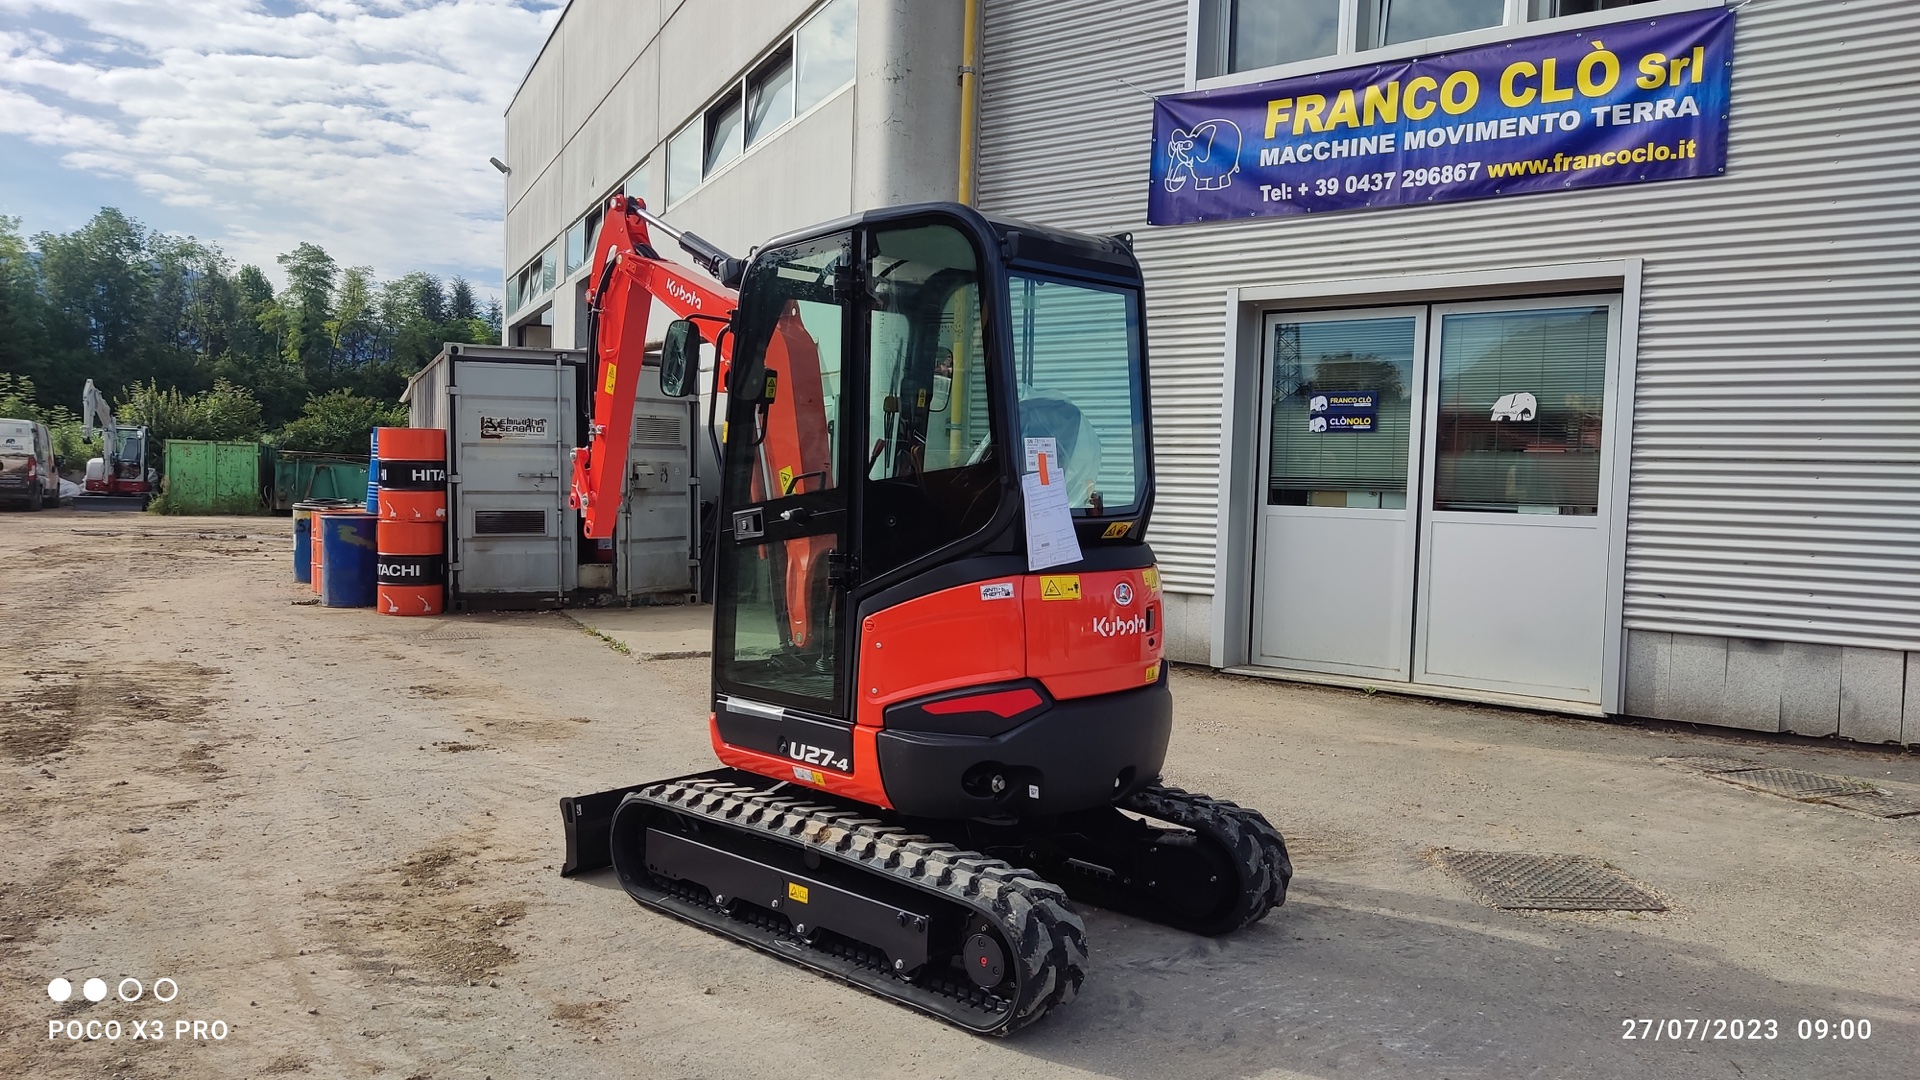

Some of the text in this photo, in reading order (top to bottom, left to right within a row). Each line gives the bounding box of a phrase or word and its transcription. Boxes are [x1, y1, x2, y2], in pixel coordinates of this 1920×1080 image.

[1263, 41, 1706, 139] FRANCO CLÒ Srl
[1259, 94, 1700, 167] MACCHINE MOVIMENTO TERRA
[1260, 183, 1292, 203] Tel:
[1314, 177, 1339, 198] 39
[1345, 170, 1395, 193] 0437
[1401, 162, 1481, 188] 296867
[1487, 139, 1697, 178] www.francoclo.it
[665, 278, 702, 310] Kubota
[1358, 395, 1372, 403] CLÒ
[499, 425, 545, 433] SERBATOI
[1329, 416, 1371, 425] CLÒNOLO
[1093, 613, 1146, 637] Kubota
[789, 742, 848, 771] U27-4
